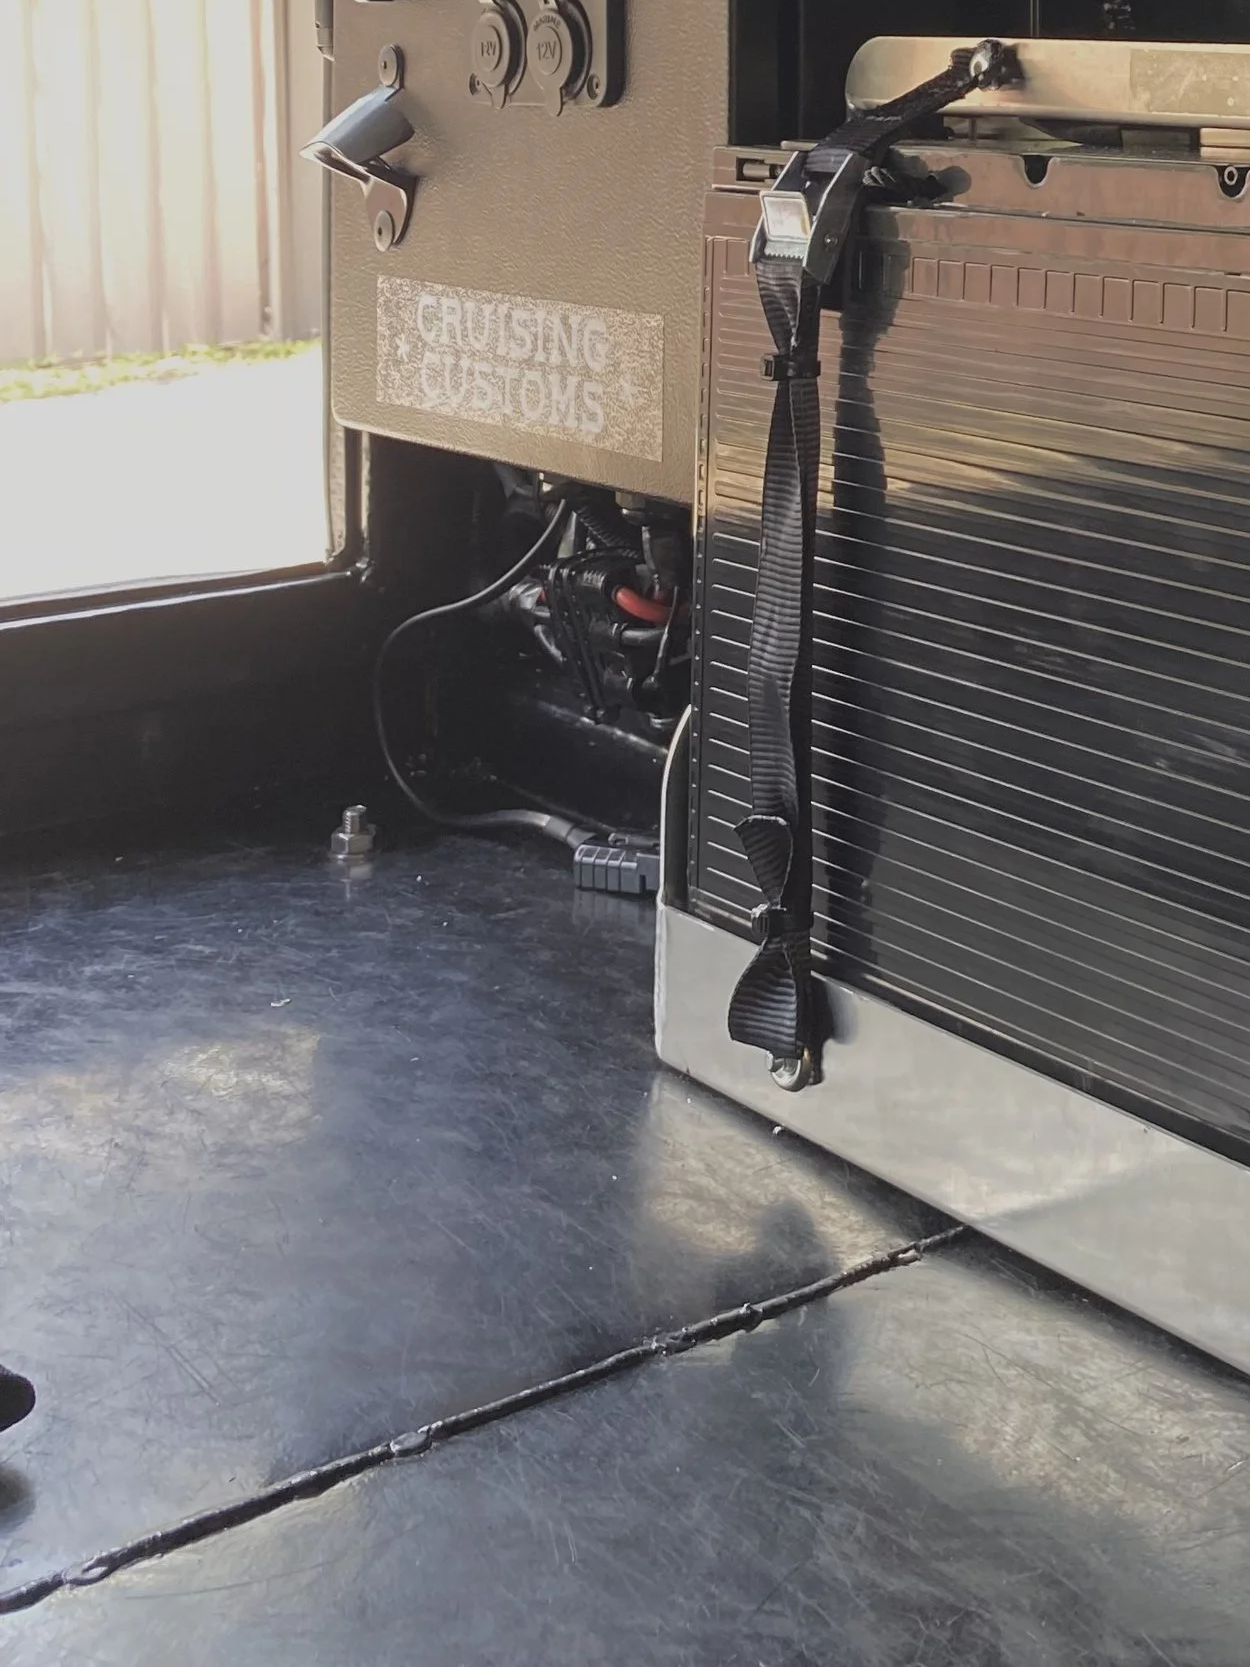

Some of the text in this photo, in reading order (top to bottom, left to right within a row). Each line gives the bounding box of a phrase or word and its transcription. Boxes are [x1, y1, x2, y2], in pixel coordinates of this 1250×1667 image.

[536, 40, 557, 60] 12V
[417, 293, 607, 372] CRUISING
[419, 350, 605, 435] CUSTOMS
